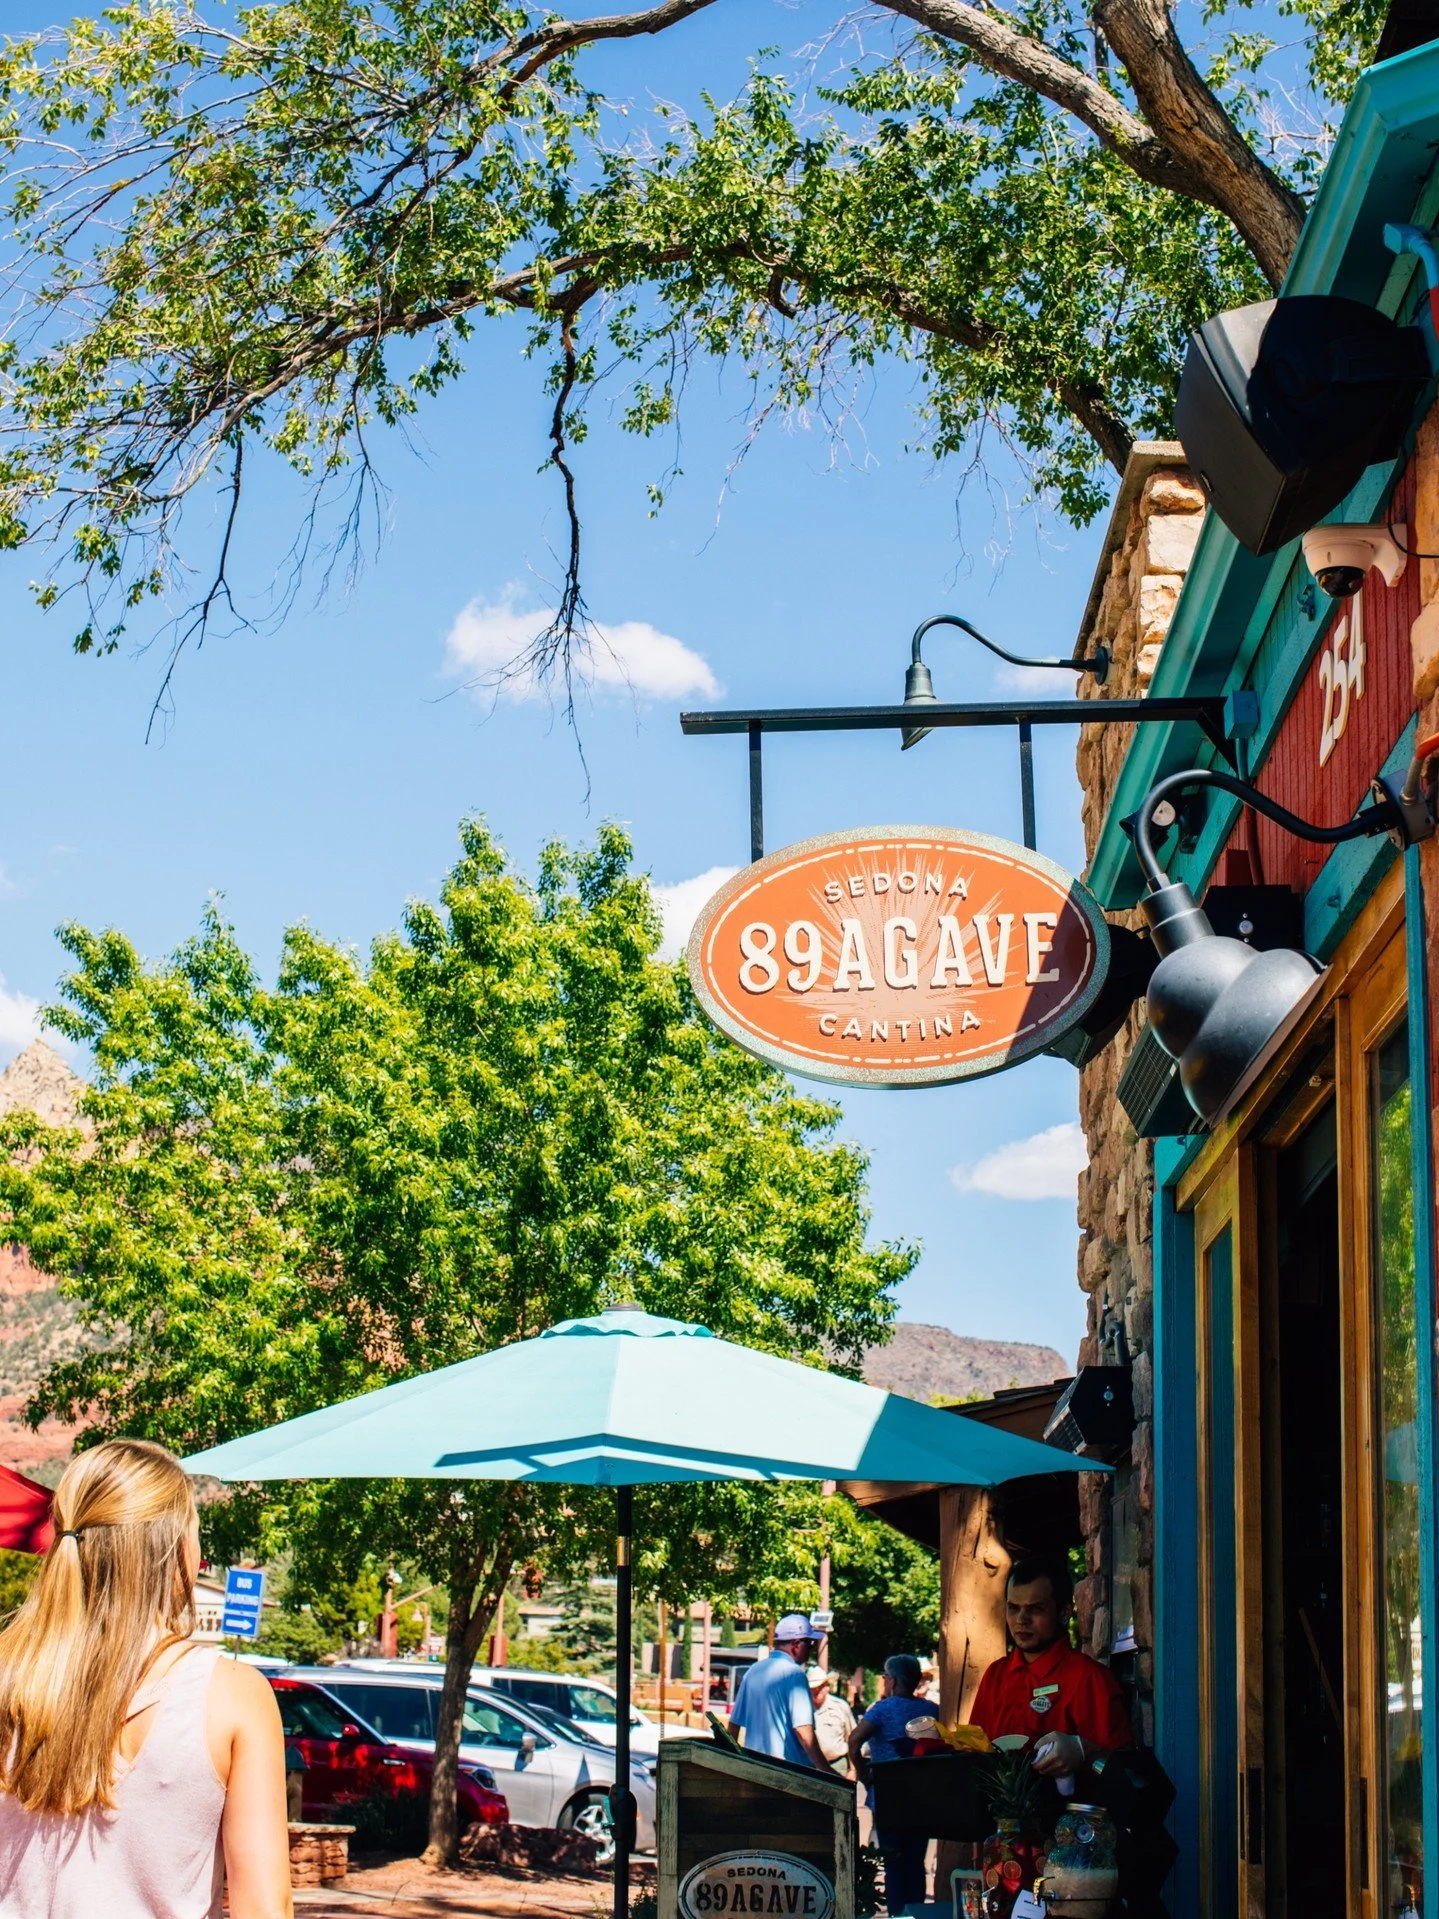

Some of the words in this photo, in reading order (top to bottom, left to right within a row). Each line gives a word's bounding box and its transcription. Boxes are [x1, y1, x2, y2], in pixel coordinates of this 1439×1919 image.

[1319, 588, 1366, 768] 254
[824, 871, 969, 903] SEDONA
[818, 1009, 982, 1043] CANTINA
[727, 1867, 787, 1880] SEDONA
